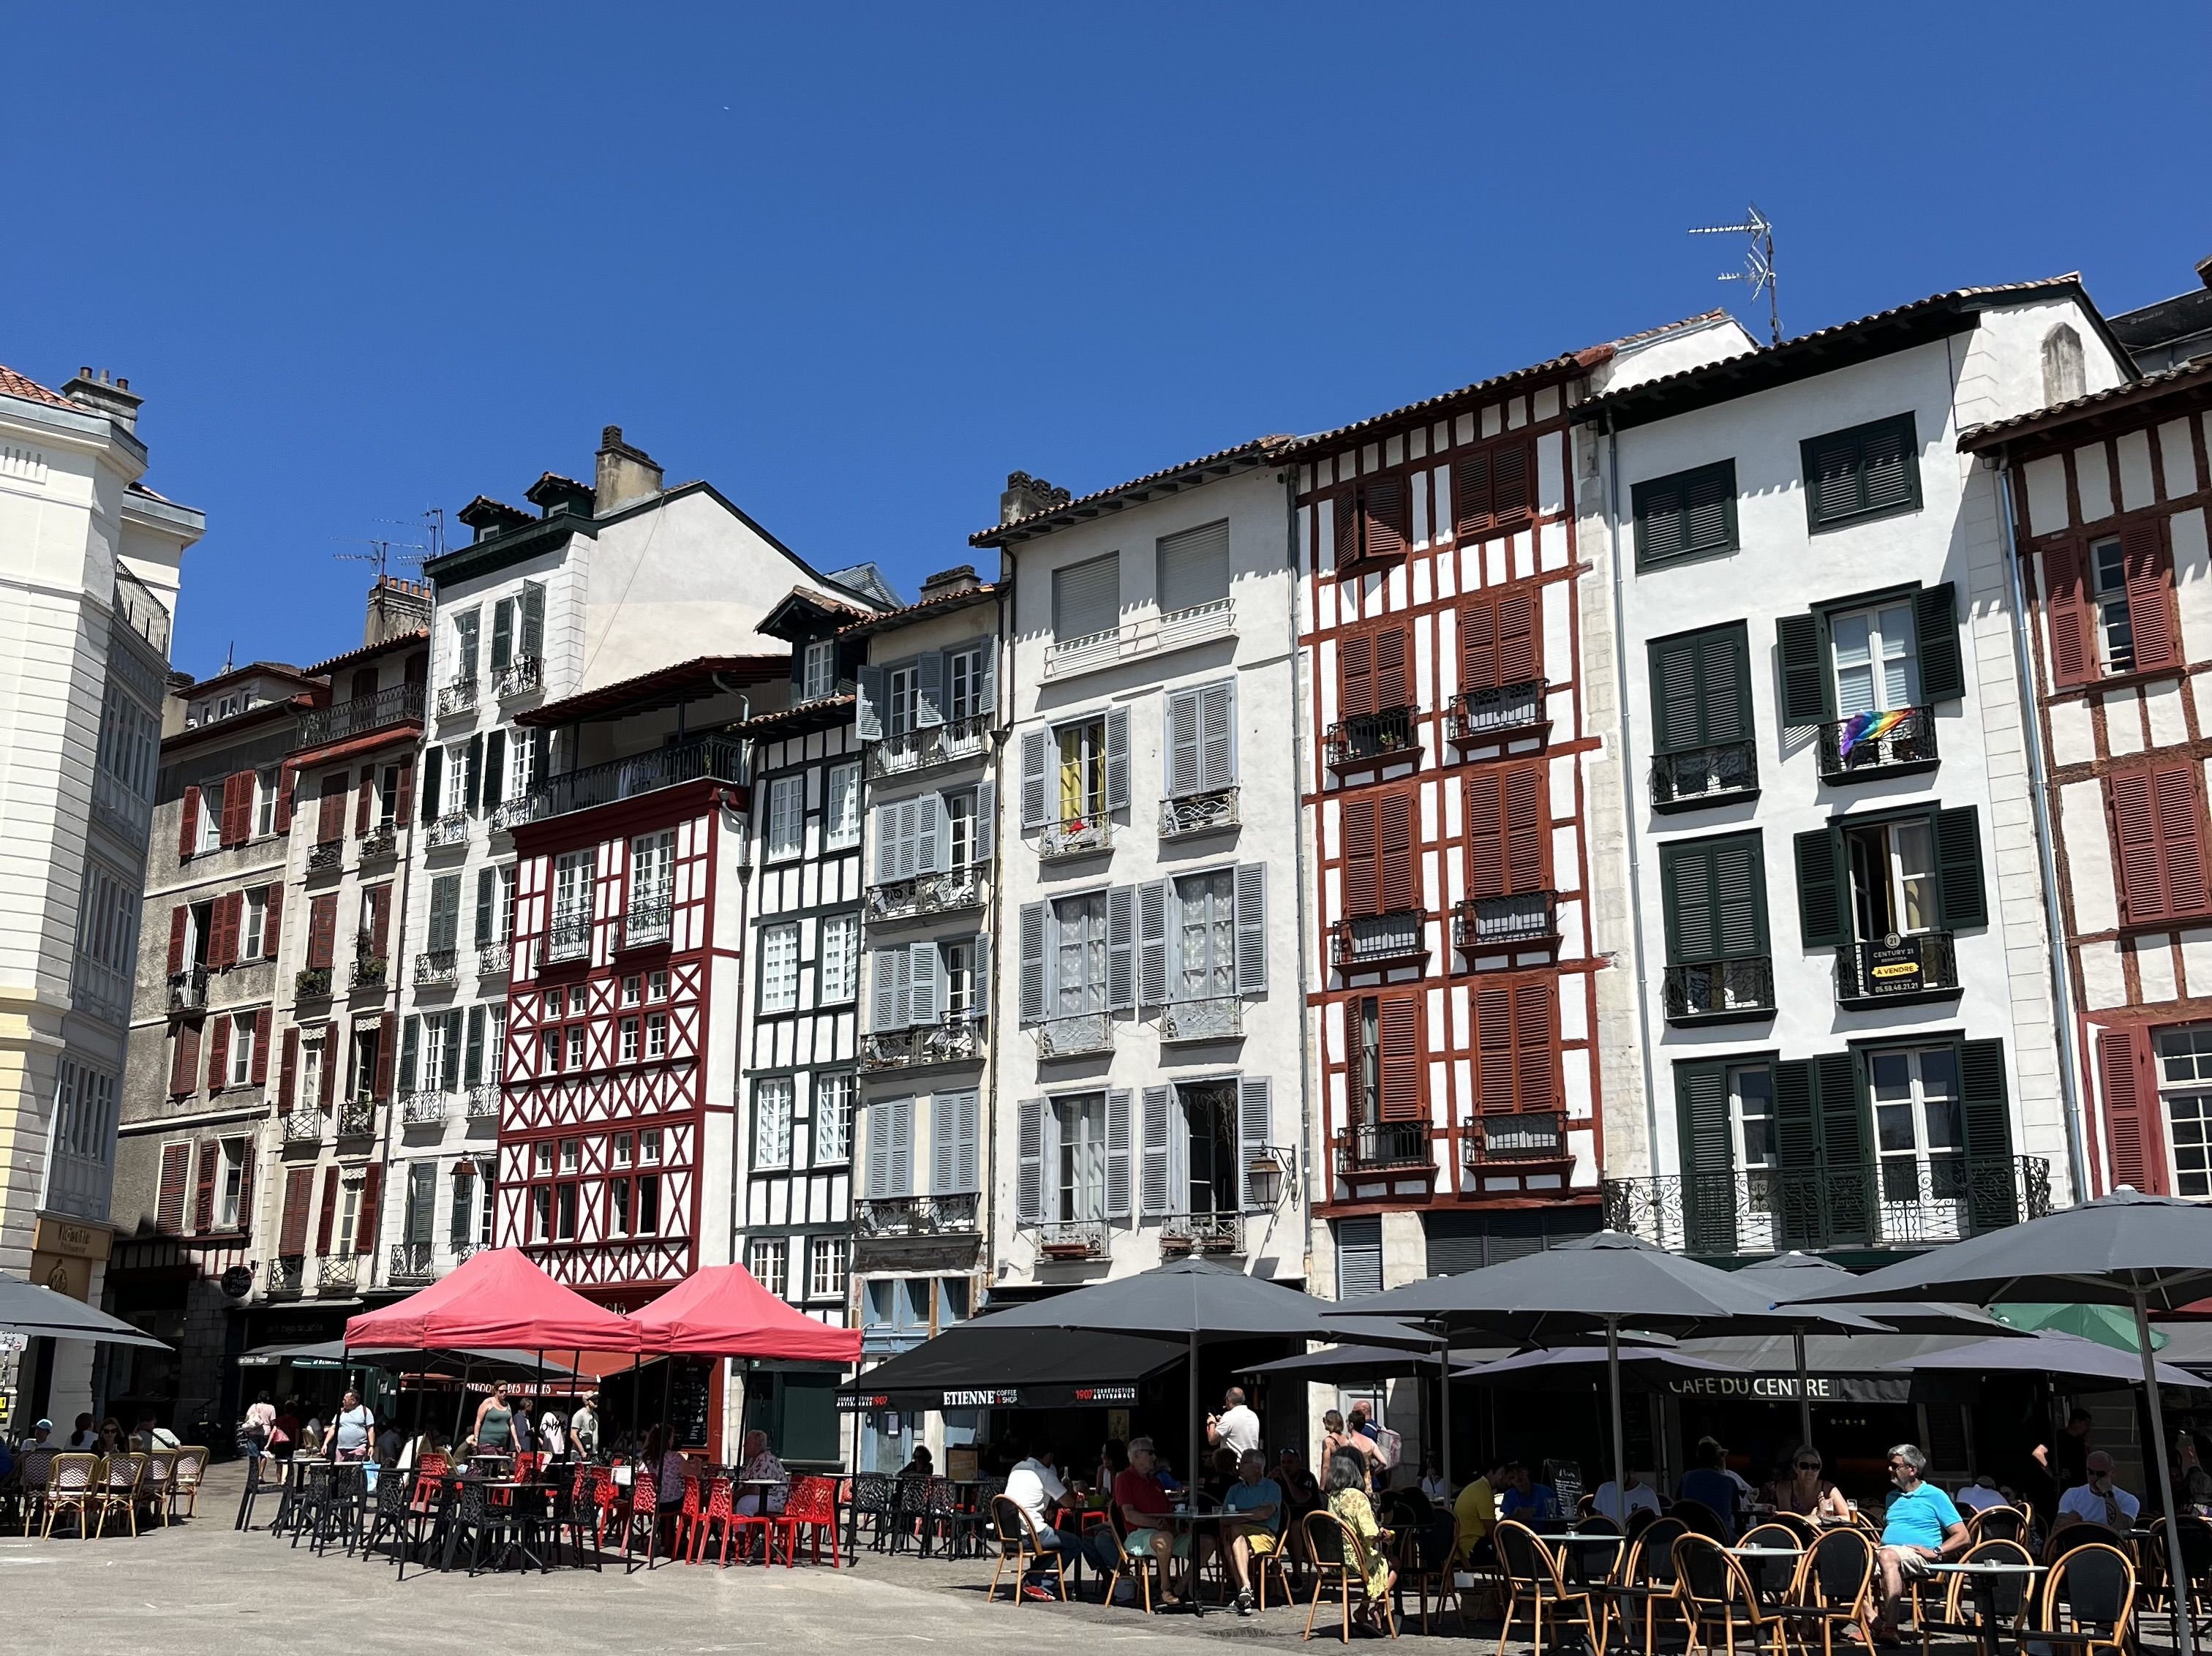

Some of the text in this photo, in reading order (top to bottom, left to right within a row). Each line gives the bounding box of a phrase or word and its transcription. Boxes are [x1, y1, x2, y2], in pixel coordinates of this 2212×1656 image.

[1873, 949, 1906, 958] CENTURY
[1884, 966, 1914, 974] VENDRE
[524, 1384, 552, 1395] HALES
[1720, 1377, 1750, 1395] DU
[1753, 1377, 1830, 1396] CENTRE
[943, 1390, 995, 1405] ETIENNE
[1075, 1389, 1094, 1400] 1907
[873, 1396, 888, 1405] 1907
